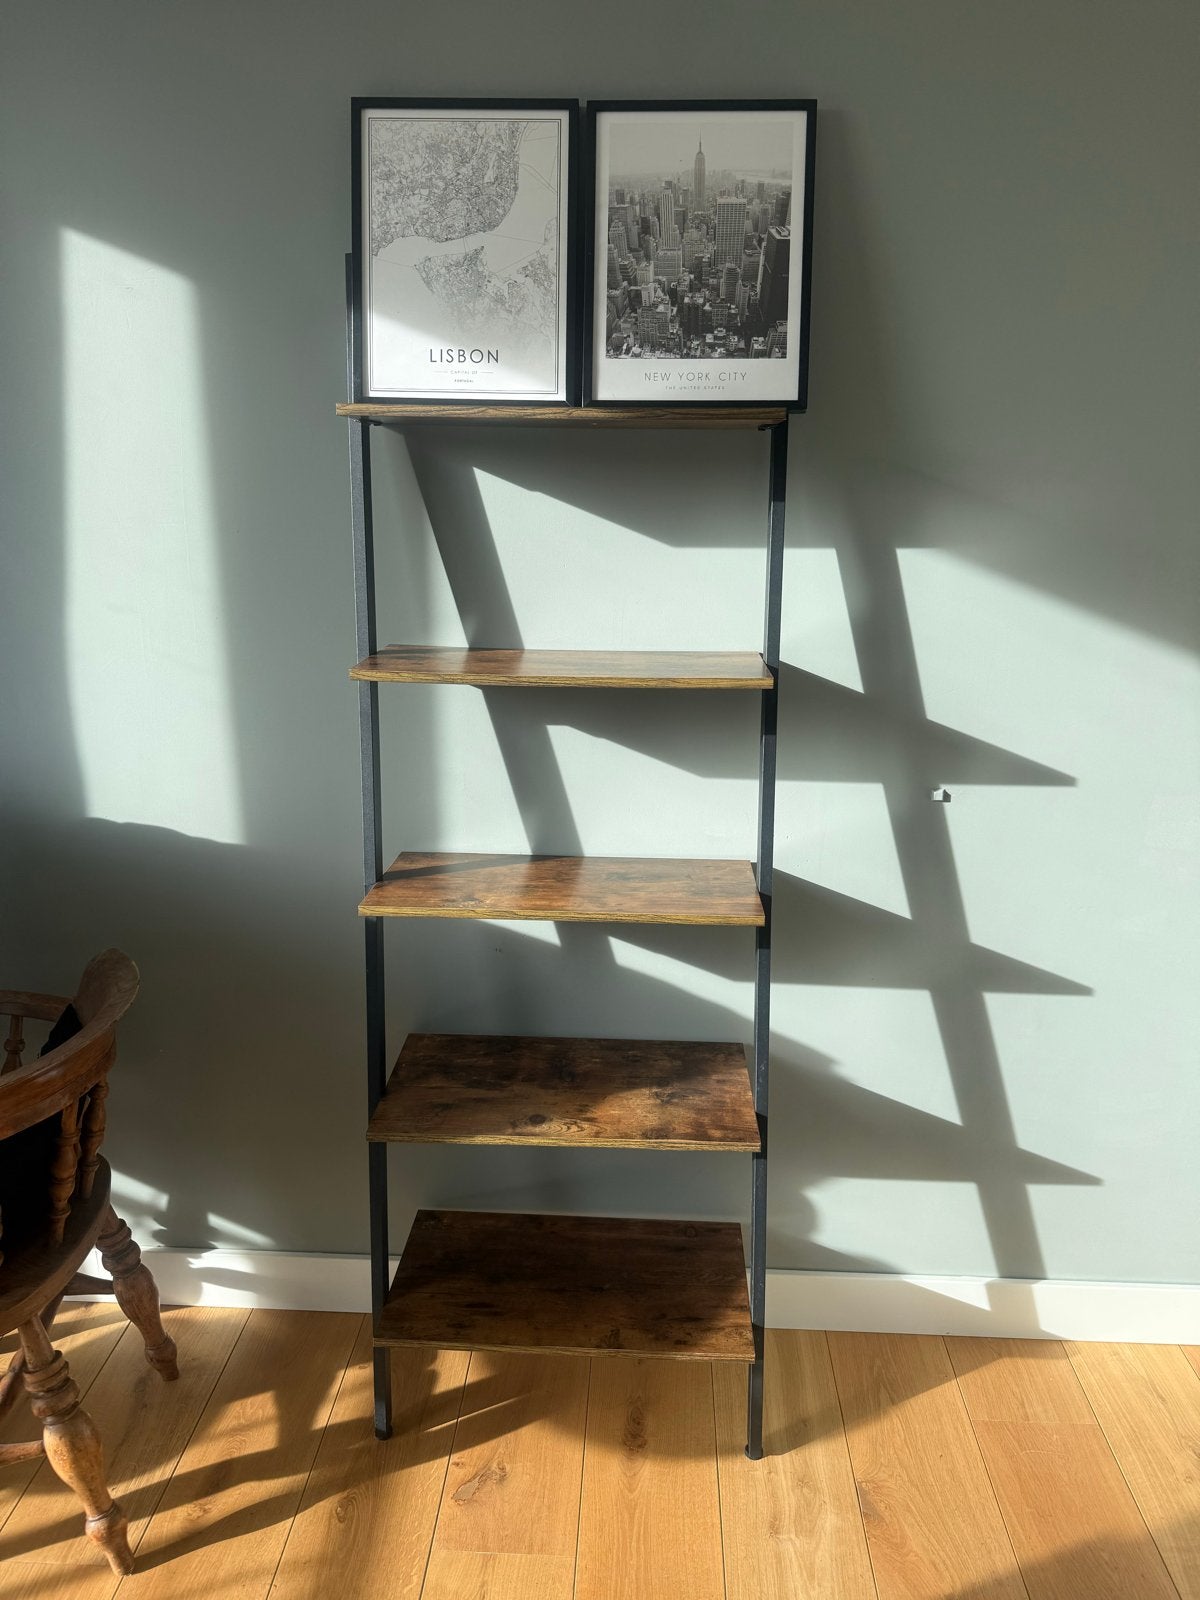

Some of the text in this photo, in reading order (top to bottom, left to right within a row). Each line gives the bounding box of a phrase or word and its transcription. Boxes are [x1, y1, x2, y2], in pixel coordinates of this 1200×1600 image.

[430, 349, 499, 363] LISBON
[644, 372, 747, 381] NEW YORK CITY
